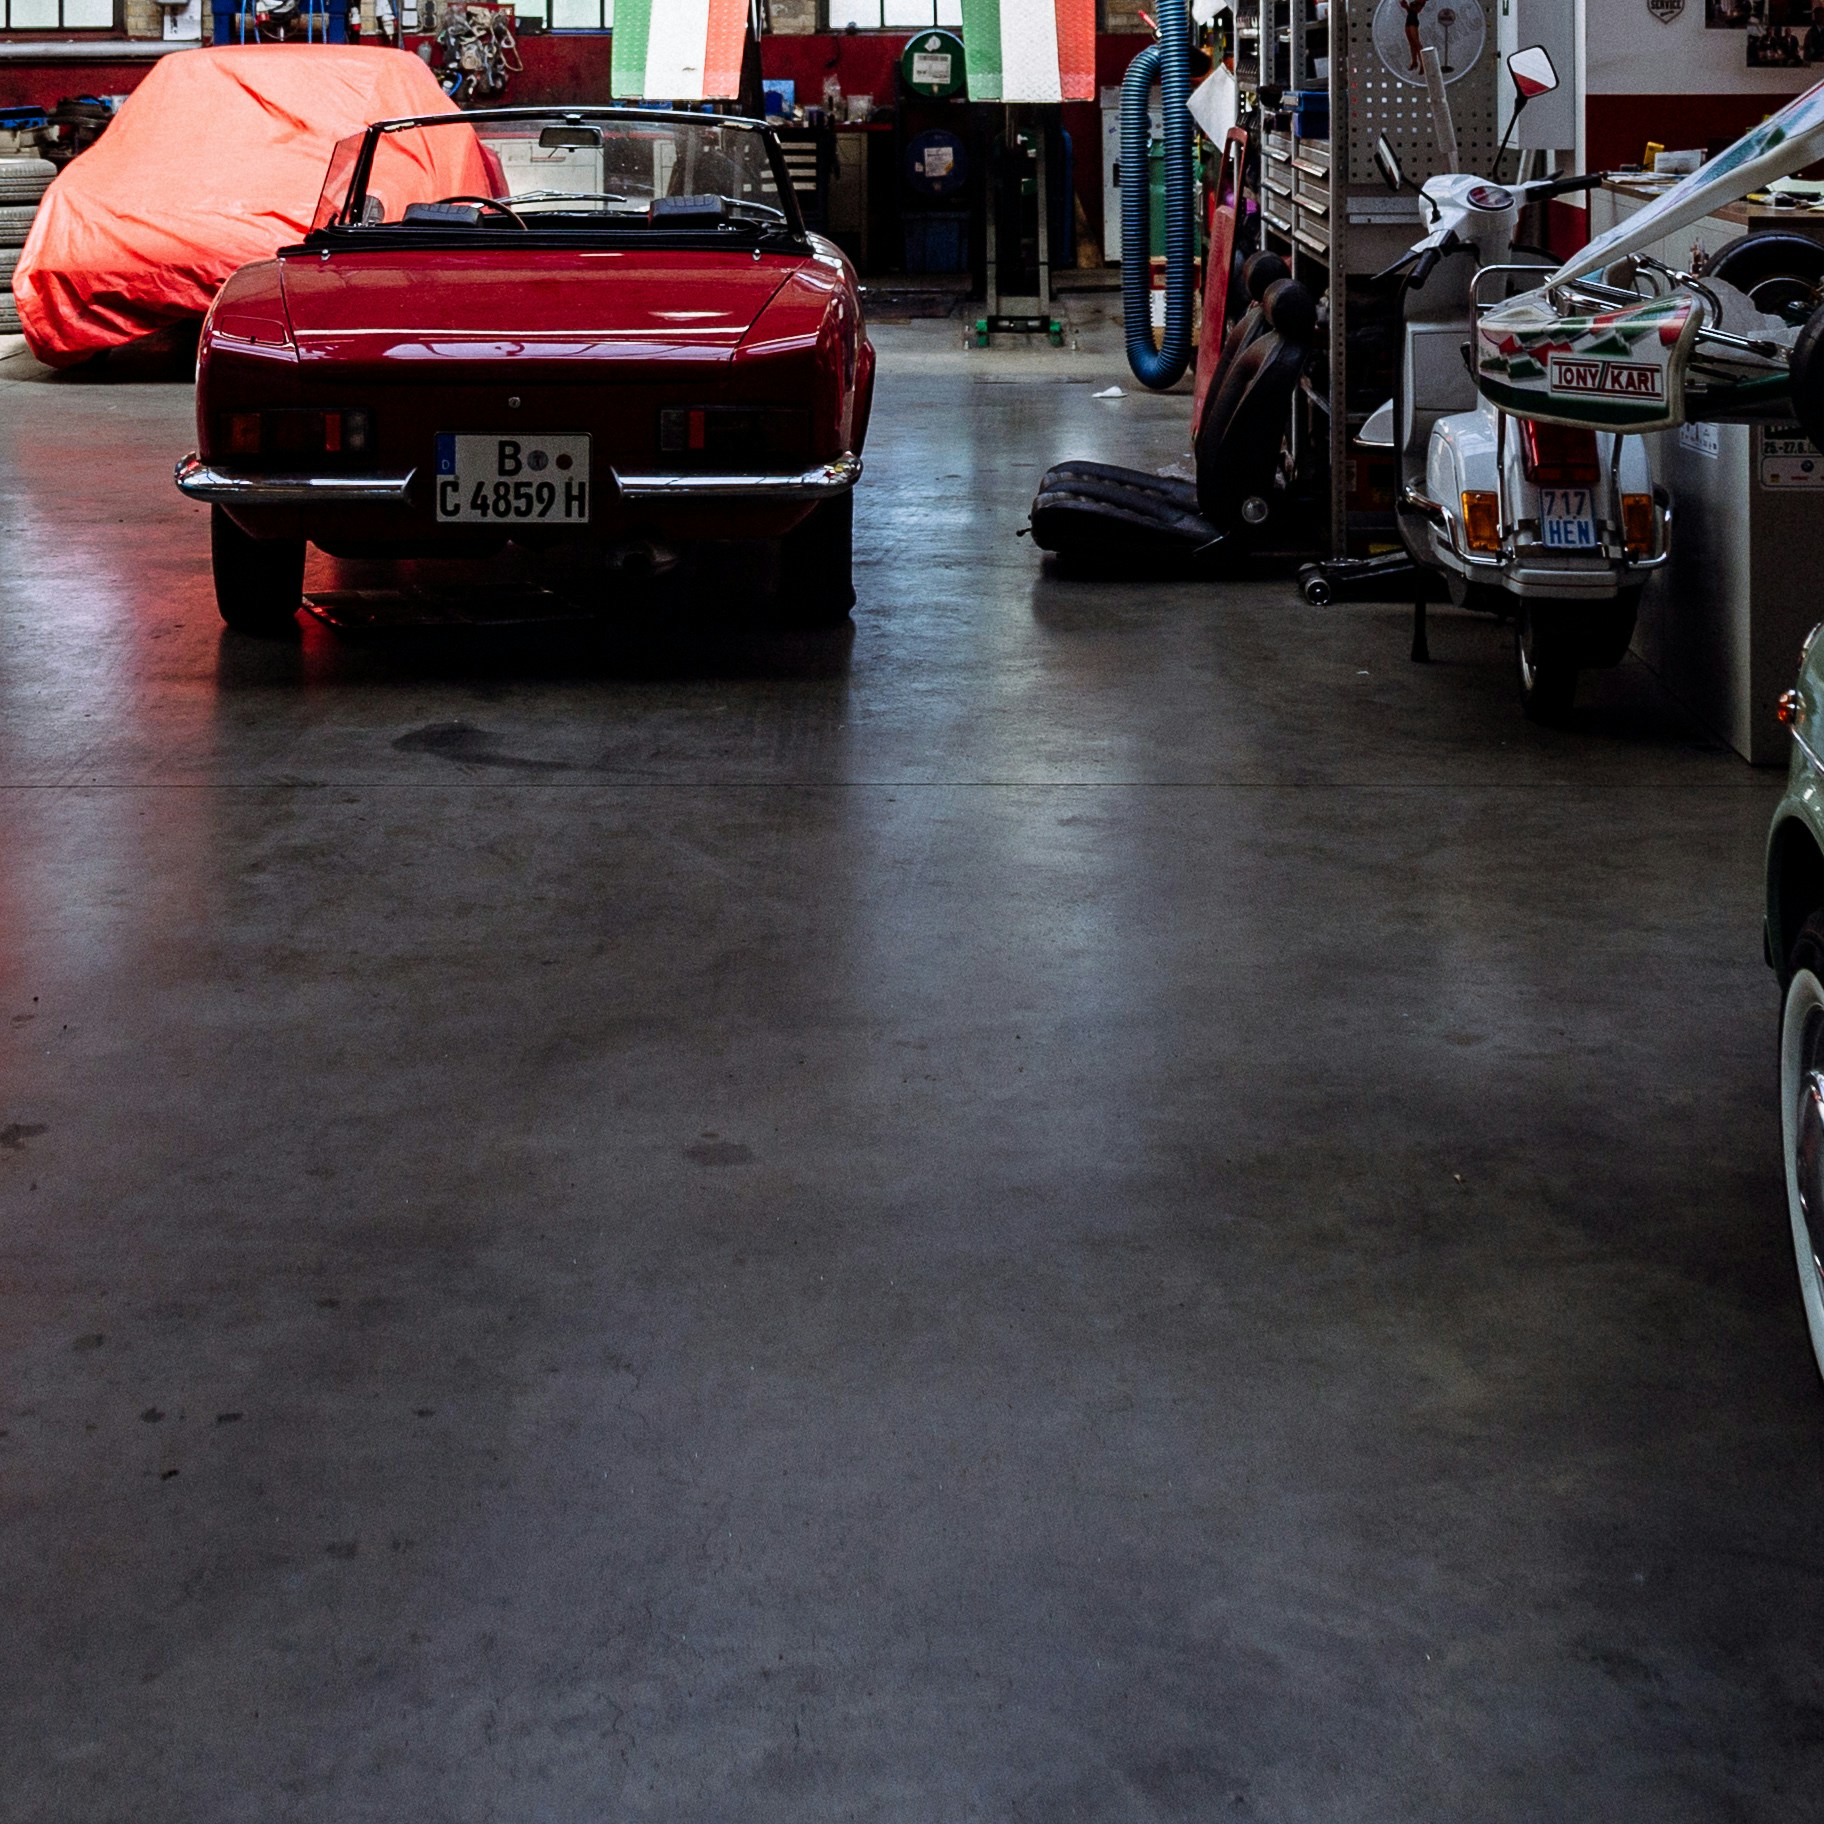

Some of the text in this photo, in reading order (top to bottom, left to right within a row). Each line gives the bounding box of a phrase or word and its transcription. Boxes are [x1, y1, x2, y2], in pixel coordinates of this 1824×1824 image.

[1650, 0, 1682, 10] SERVICE
[1553, 360, 1660, 393] TONY KART
[497, 440, 523, 476] B
[439, 480, 586, 518] C 4859 H
[1544, 491, 1586, 516] 717
[1548, 520, 1590, 544] HEN
